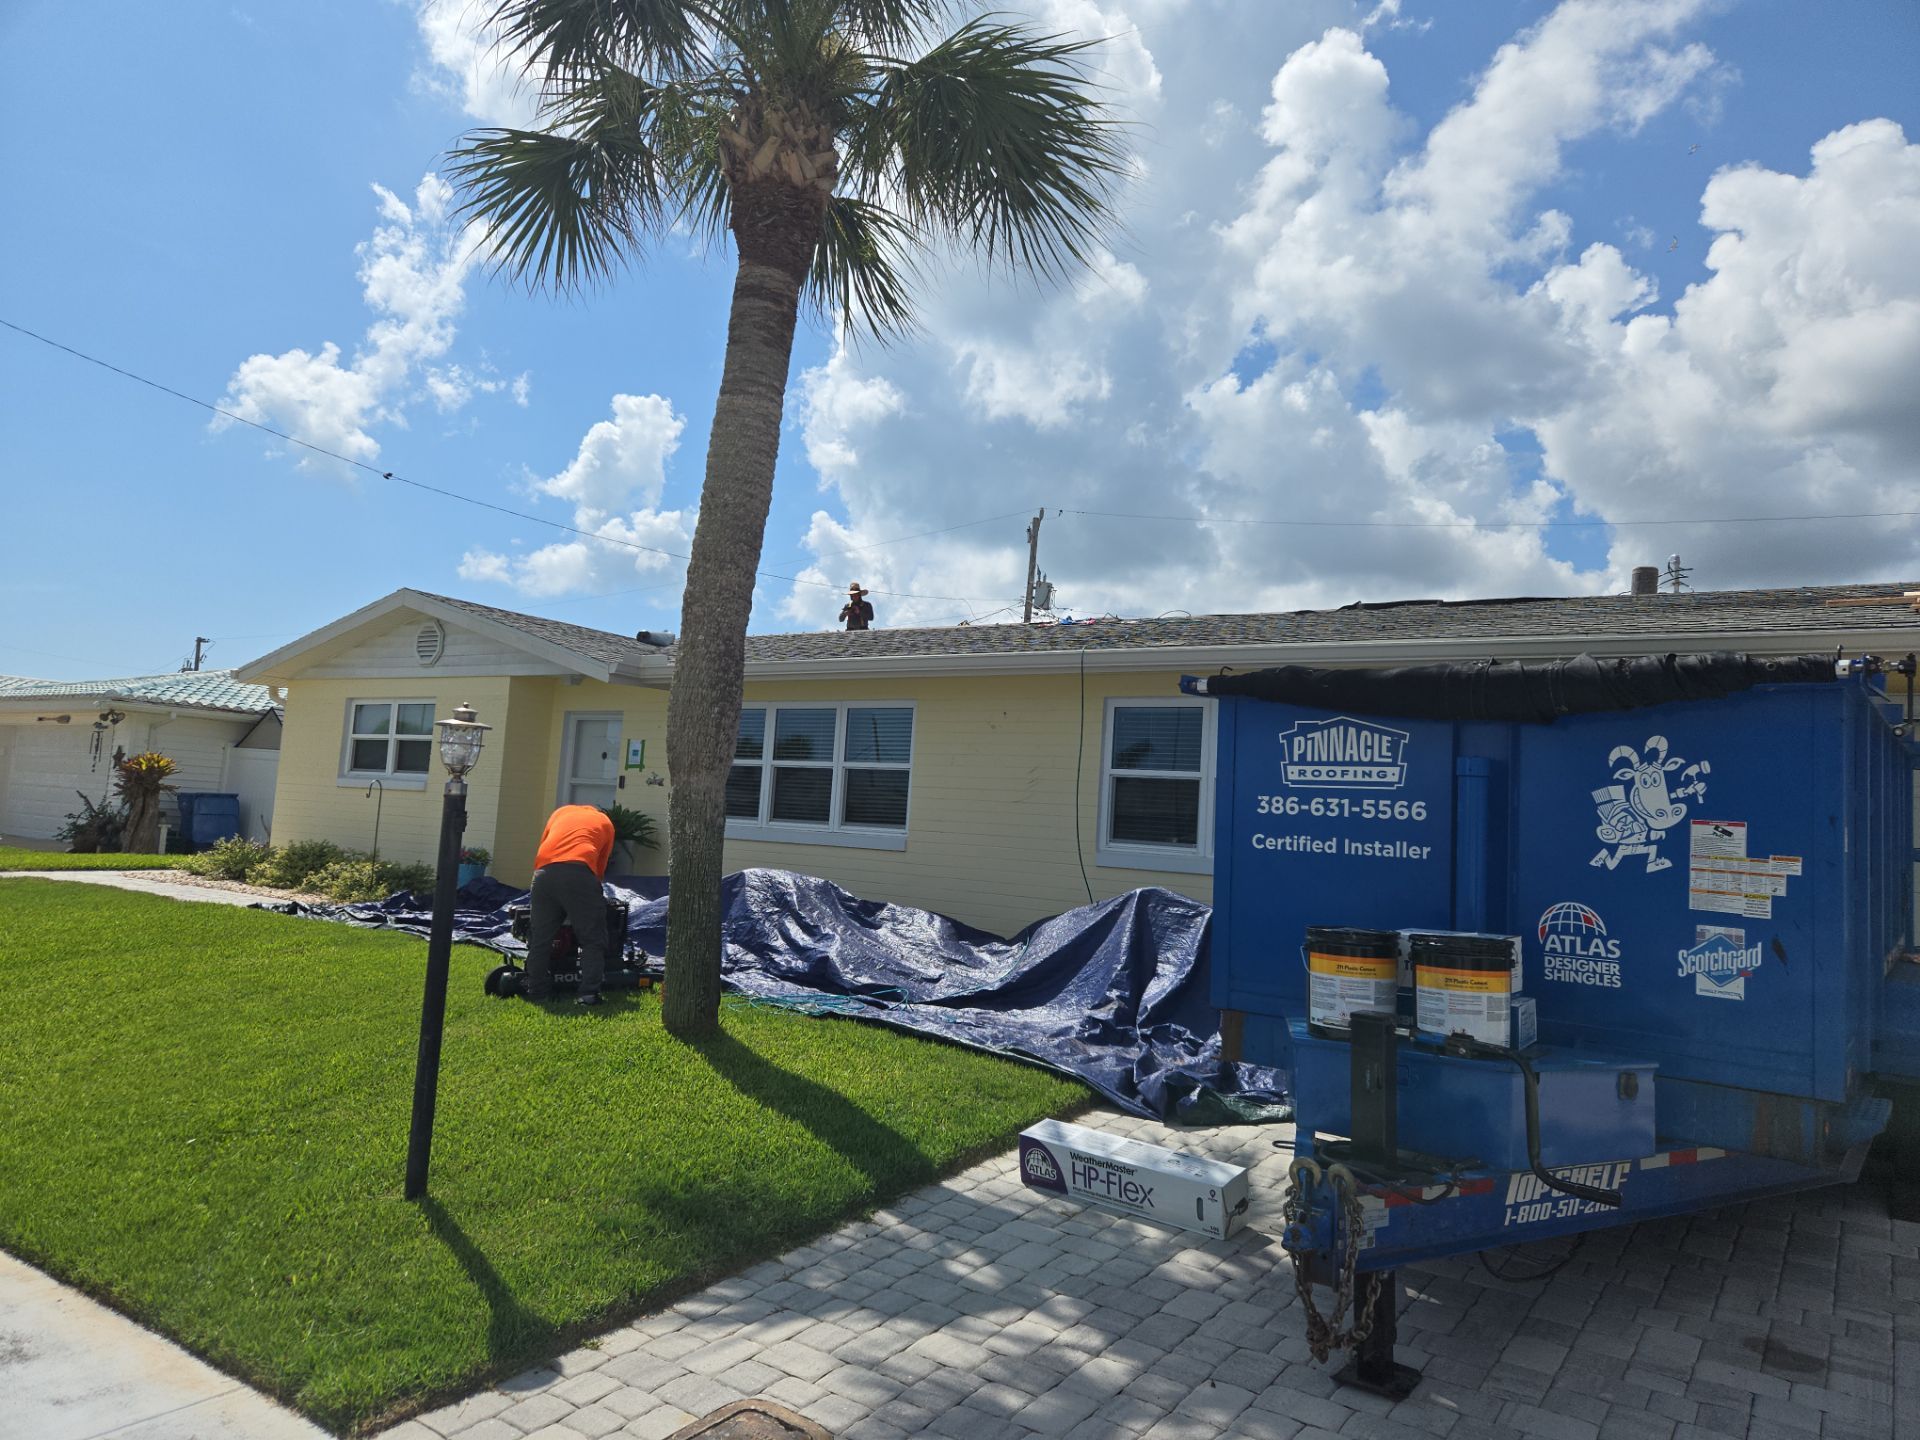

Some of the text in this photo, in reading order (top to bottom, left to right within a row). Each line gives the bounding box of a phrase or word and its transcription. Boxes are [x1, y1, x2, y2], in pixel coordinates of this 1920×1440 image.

[1292, 725, 1393, 763] PINNACLE
[1297, 769, 1388, 779] ROOFING
[1256, 795, 1427, 821] 386-631-5566
[1251, 833, 1431, 859] Certified Installer
[1544, 934, 1621, 959] ATLAS
[1544, 955, 1621, 976] DESIGNER
[1677, 942, 1762, 977] Scotchgard
[1544, 968, 1622, 988] SHINGLES
[1029, 1163, 1056, 1179] ATLAS
[1069, 1151, 1136, 1176] WeatherMaster
[1071, 1161, 1156, 1209] HP-Flex
